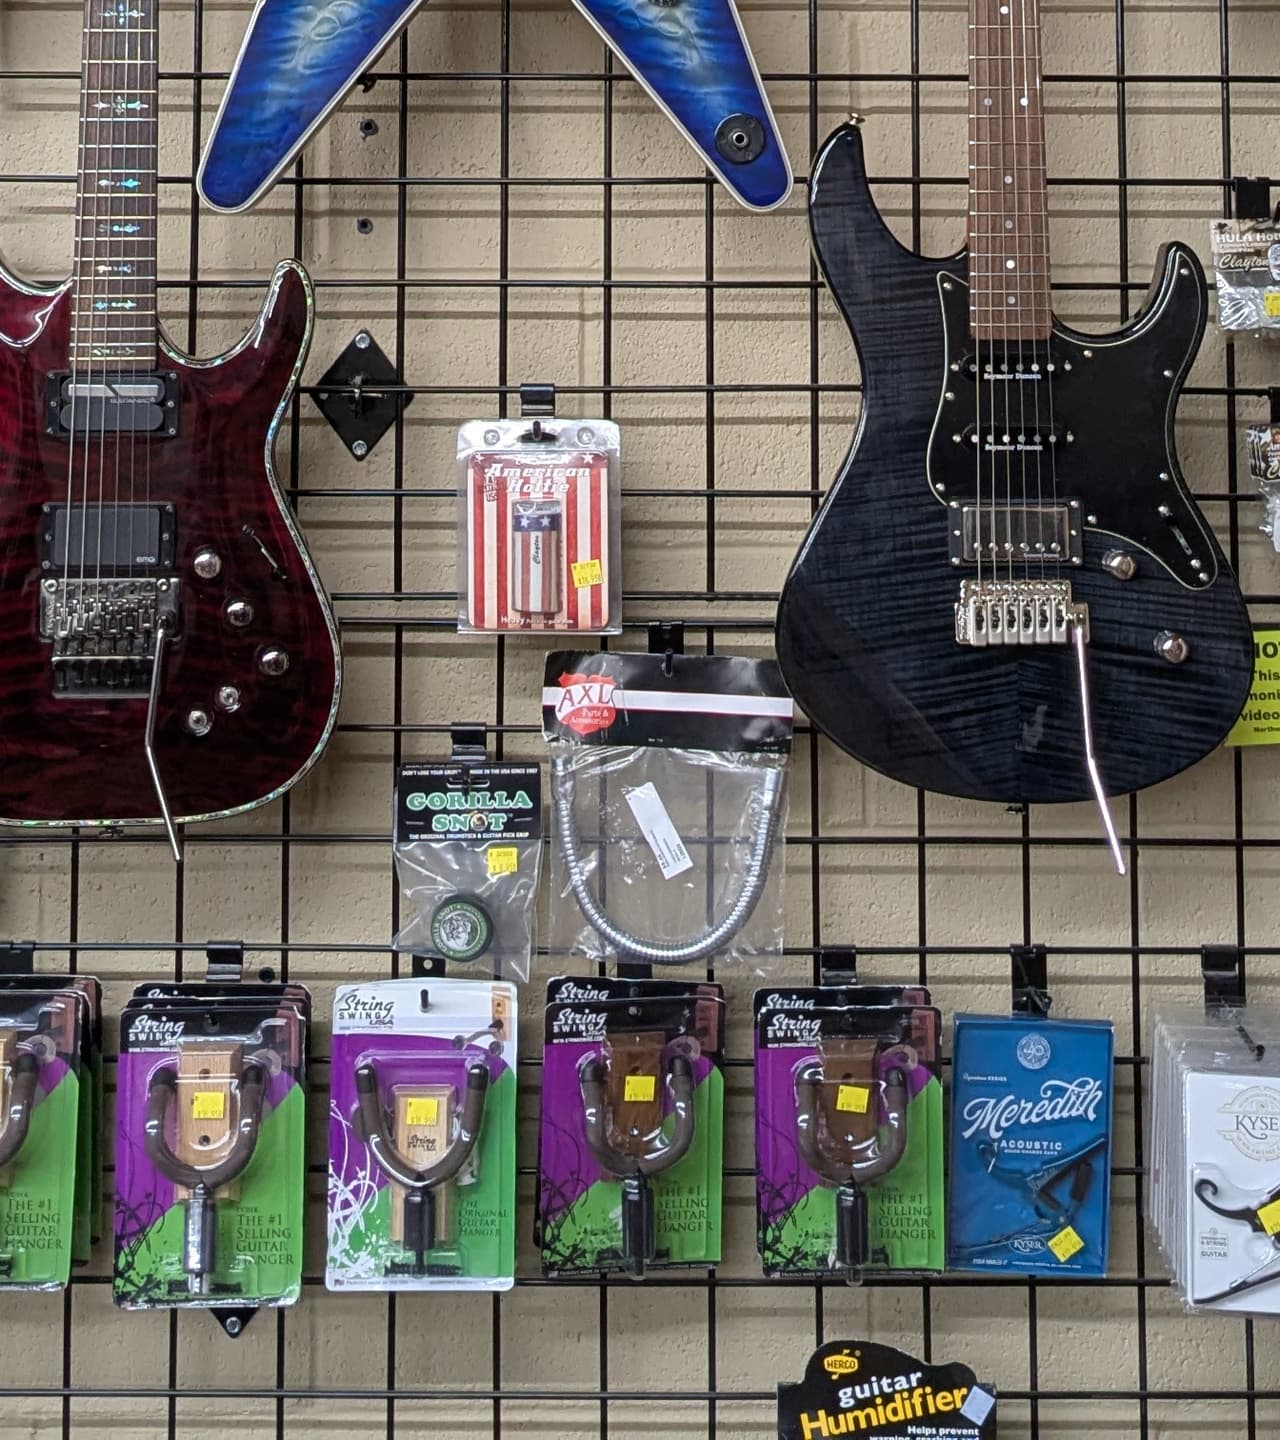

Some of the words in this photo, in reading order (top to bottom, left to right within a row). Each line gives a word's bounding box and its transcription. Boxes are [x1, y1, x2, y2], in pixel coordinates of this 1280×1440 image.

[1216, 233, 1252, 243] HULA
[484, 463, 591, 477] American
[506, 477, 571, 494] Hottie
[558, 684, 612, 712] AXL
[1241, 710, 1280, 721] video
[406, 791, 533, 811] GORILLA
[339, 993, 395, 1018] String
[339, 1012, 381, 1020] SWING
[553, 1007, 608, 1029] String
[129, 1014, 185, 1039] String
[553, 1024, 595, 1033] SWING
[767, 1013, 822, 1035] String
[129, 1032, 173, 1042] SWING
[767, 1029, 809, 1038] SWING
[962, 1077, 1103, 1140] Meredith
[1000, 1139, 1063, 1151] ACOUSTIC
[659, 1186, 684, 1197] THE
[688, 1186, 702, 1197] #1
[8, 1199, 34, 1210] THE
[38, 1199, 53, 1209] #1
[657, 1198, 710, 1209] SELLING
[881, 1194, 904, 1204] THE
[910, 1194, 923, 1204] #1
[458, 1209, 510, 1218] ORIGINAL
[656, 1210, 707, 1221] GUITAR
[879, 1206, 932, 1216] SELLING
[5, 1213, 61, 1224] SELLING
[237, 1214, 264, 1225] THE
[268, 1214, 282, 1225] #1
[879, 1217, 930, 1228] GUITAR
[5, 1225, 57, 1237] GUITAR
[656, 1221, 713, 1233] HANGER
[236, 1228, 292, 1239] SELLING
[880, 1229, 936, 1240] HANGER
[235, 1240, 288, 1252] GUITAR
[827, 1360, 856, 1370] HERCO
[838, 1371, 923, 1408] guitar
[800, 1386, 969, 1440] Humidifier
[907, 1425, 937, 1436] Helps
[938, 1427, 980, 1437] prevent
